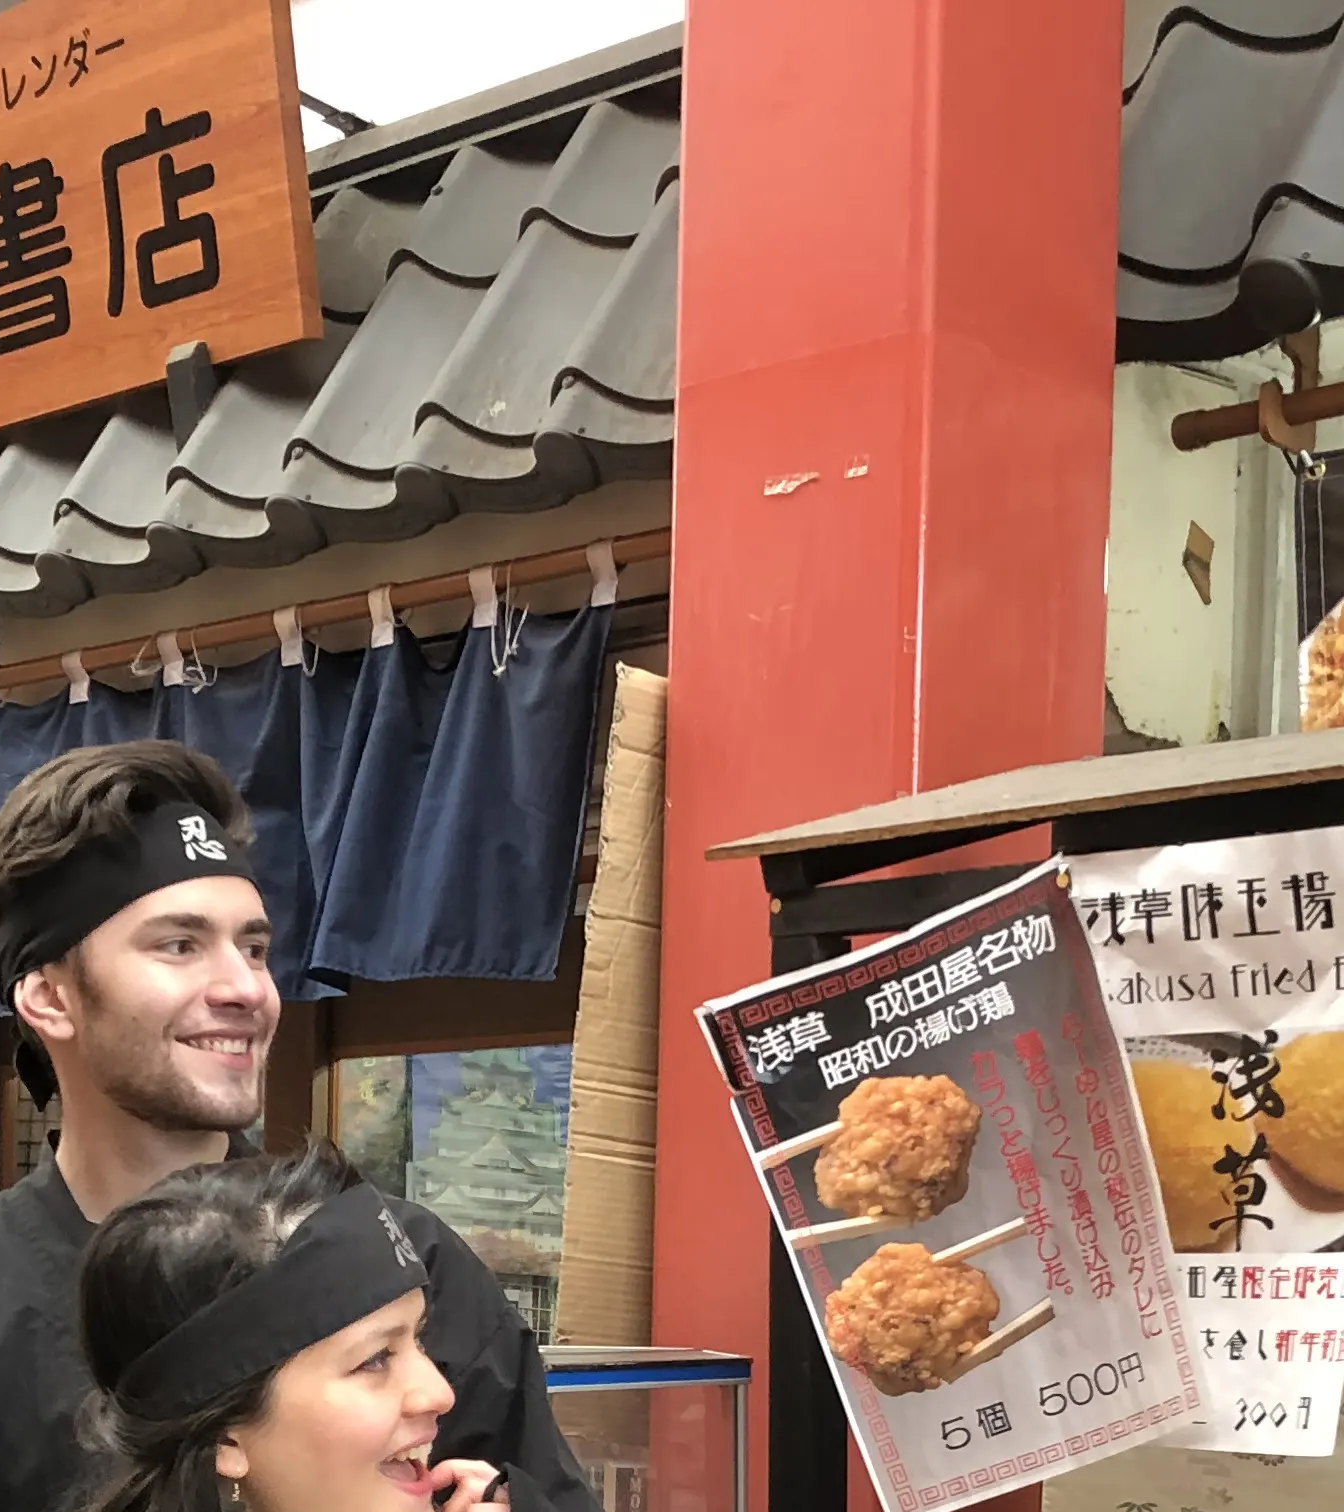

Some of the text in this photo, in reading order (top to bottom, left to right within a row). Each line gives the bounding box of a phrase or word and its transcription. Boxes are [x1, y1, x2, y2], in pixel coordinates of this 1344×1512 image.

[177, 815, 228, 861] 忍
[746, 913, 1057, 1075] 浅草 成田屋名物
[1108, 971, 1216, 1006] akusa
[1230, 958, 1317, 998] Fried
[817, 981, 1016, 1091] 昭和の揚げ鶏
[1038, 1351, 1146, 1417] 500円
